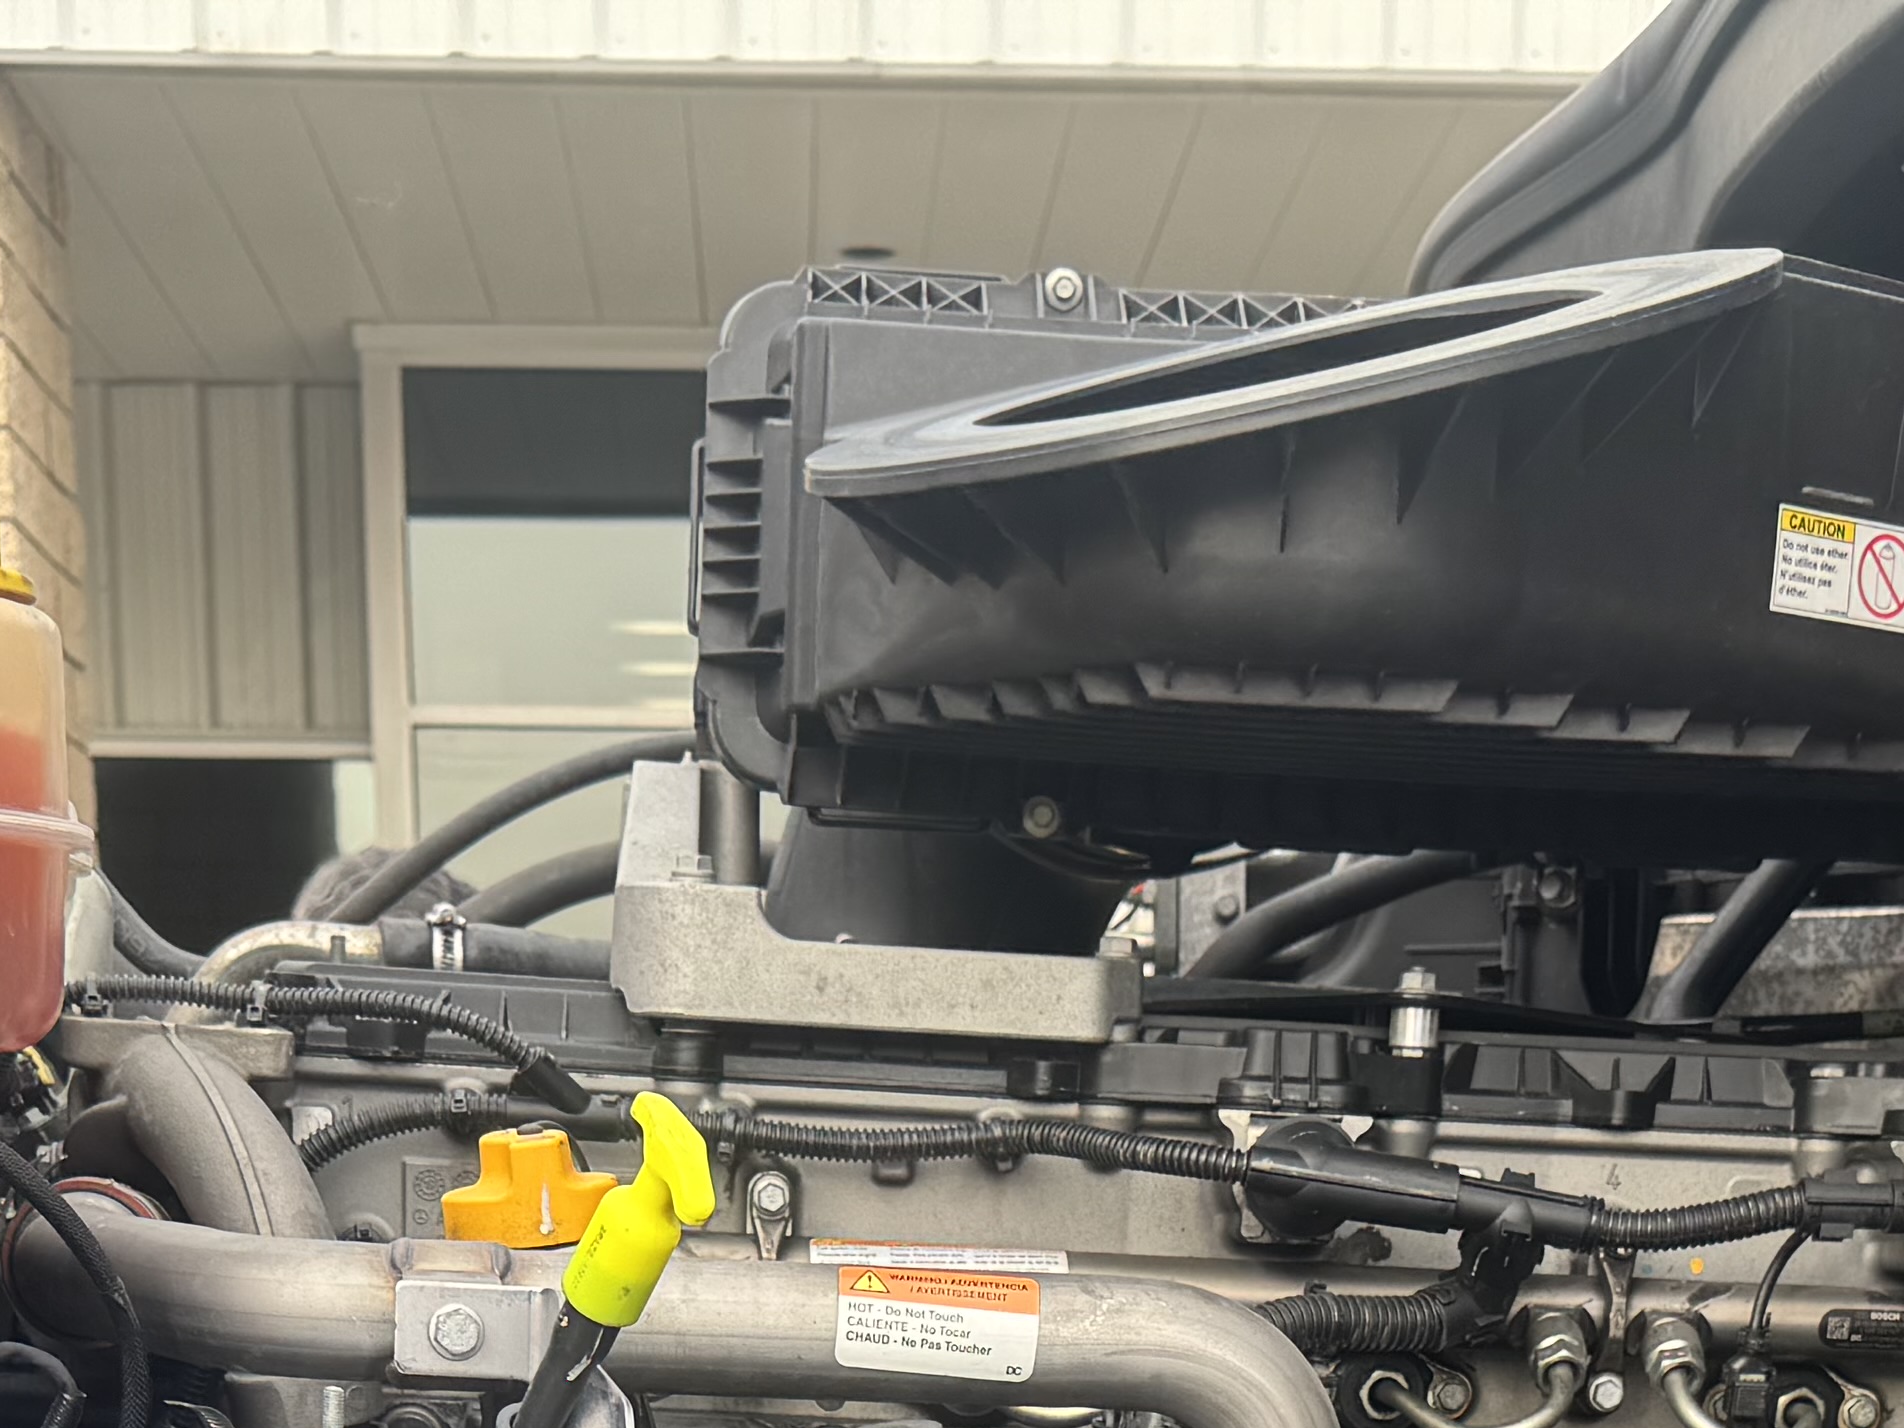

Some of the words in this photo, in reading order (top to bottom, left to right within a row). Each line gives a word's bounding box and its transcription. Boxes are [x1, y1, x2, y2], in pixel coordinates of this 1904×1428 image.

[1789, 514, 1846, 540] CAUTION
[1782, 538, 1794, 549] Do
[1796, 542, 1808, 551] not
[1811, 546, 1825, 556] use
[889, 1273, 941, 1286] WARNING
[951, 1278, 1028, 1293] ADVERTENCIA
[916, 1286, 1008, 1302] AVERTISSEMENT
[848, 1302, 873, 1314] HOT
[885, 1305, 901, 1316] Do
[905, 1307, 925, 1319] Not
[929, 1309, 964, 1324] Touch
[1870, 1312, 1900, 1321] BOSCH
[847, 1315, 908, 1332] CALIENTE
[920, 1323, 936, 1335] No
[940, 1326, 971, 1340] Tocar
[846, 1331, 890, 1345] CHAUD
[920, 1339, 941, 1351] Pas
[945, 1341, 992, 1356] Toucher
[1006, 1366, 1022, 1376] DC
